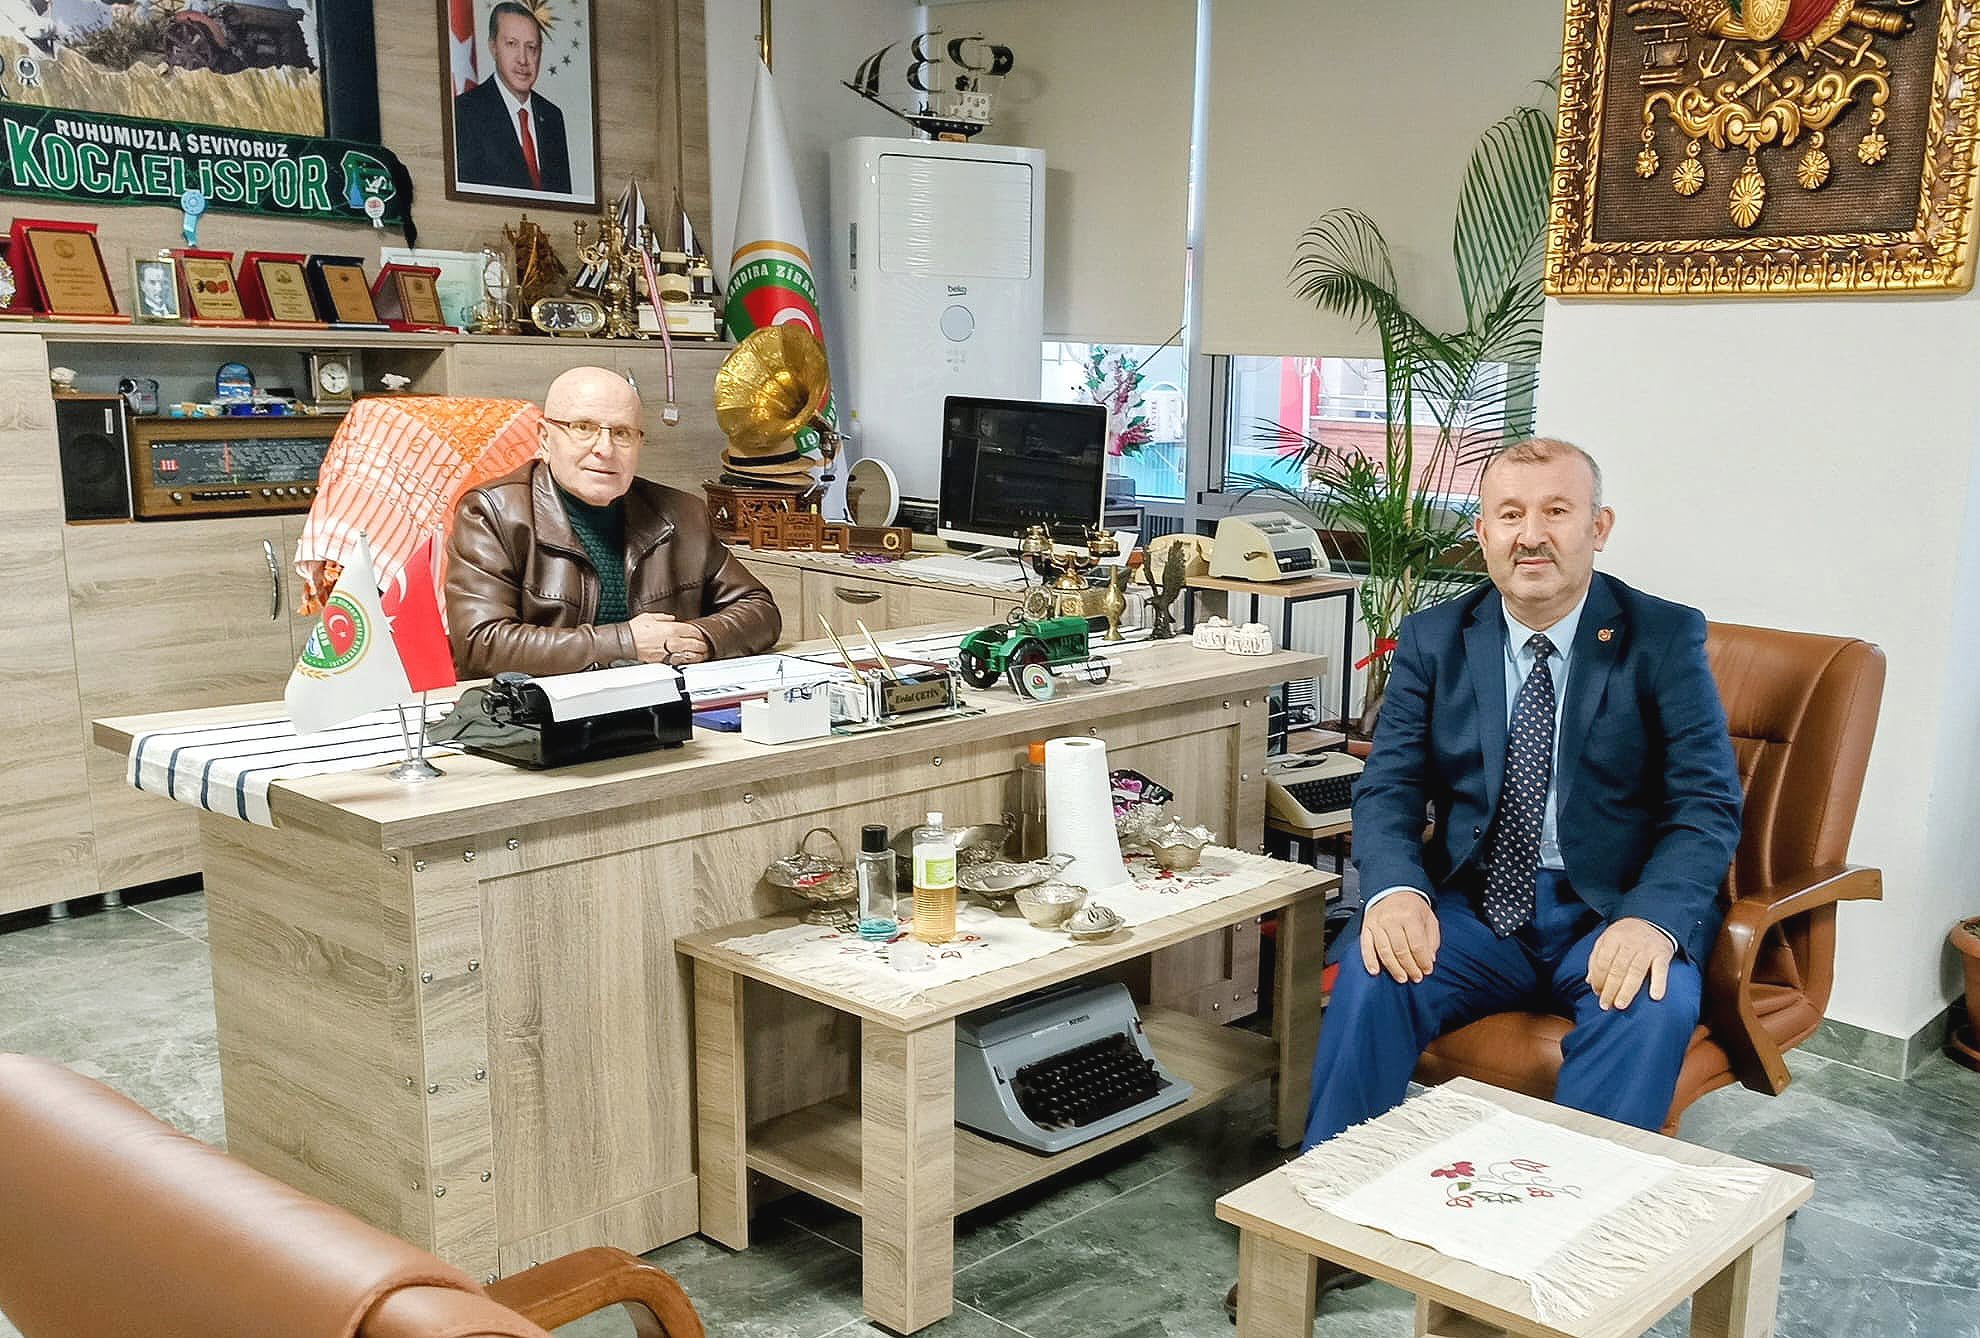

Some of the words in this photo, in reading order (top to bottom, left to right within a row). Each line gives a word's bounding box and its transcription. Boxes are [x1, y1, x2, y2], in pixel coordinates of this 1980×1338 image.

[3, 118, 332, 211] KOCAELİSPOR
[55, 119, 182, 152] RUHUMUZLA
[187, 133, 289, 158] SEVİYORUZ
